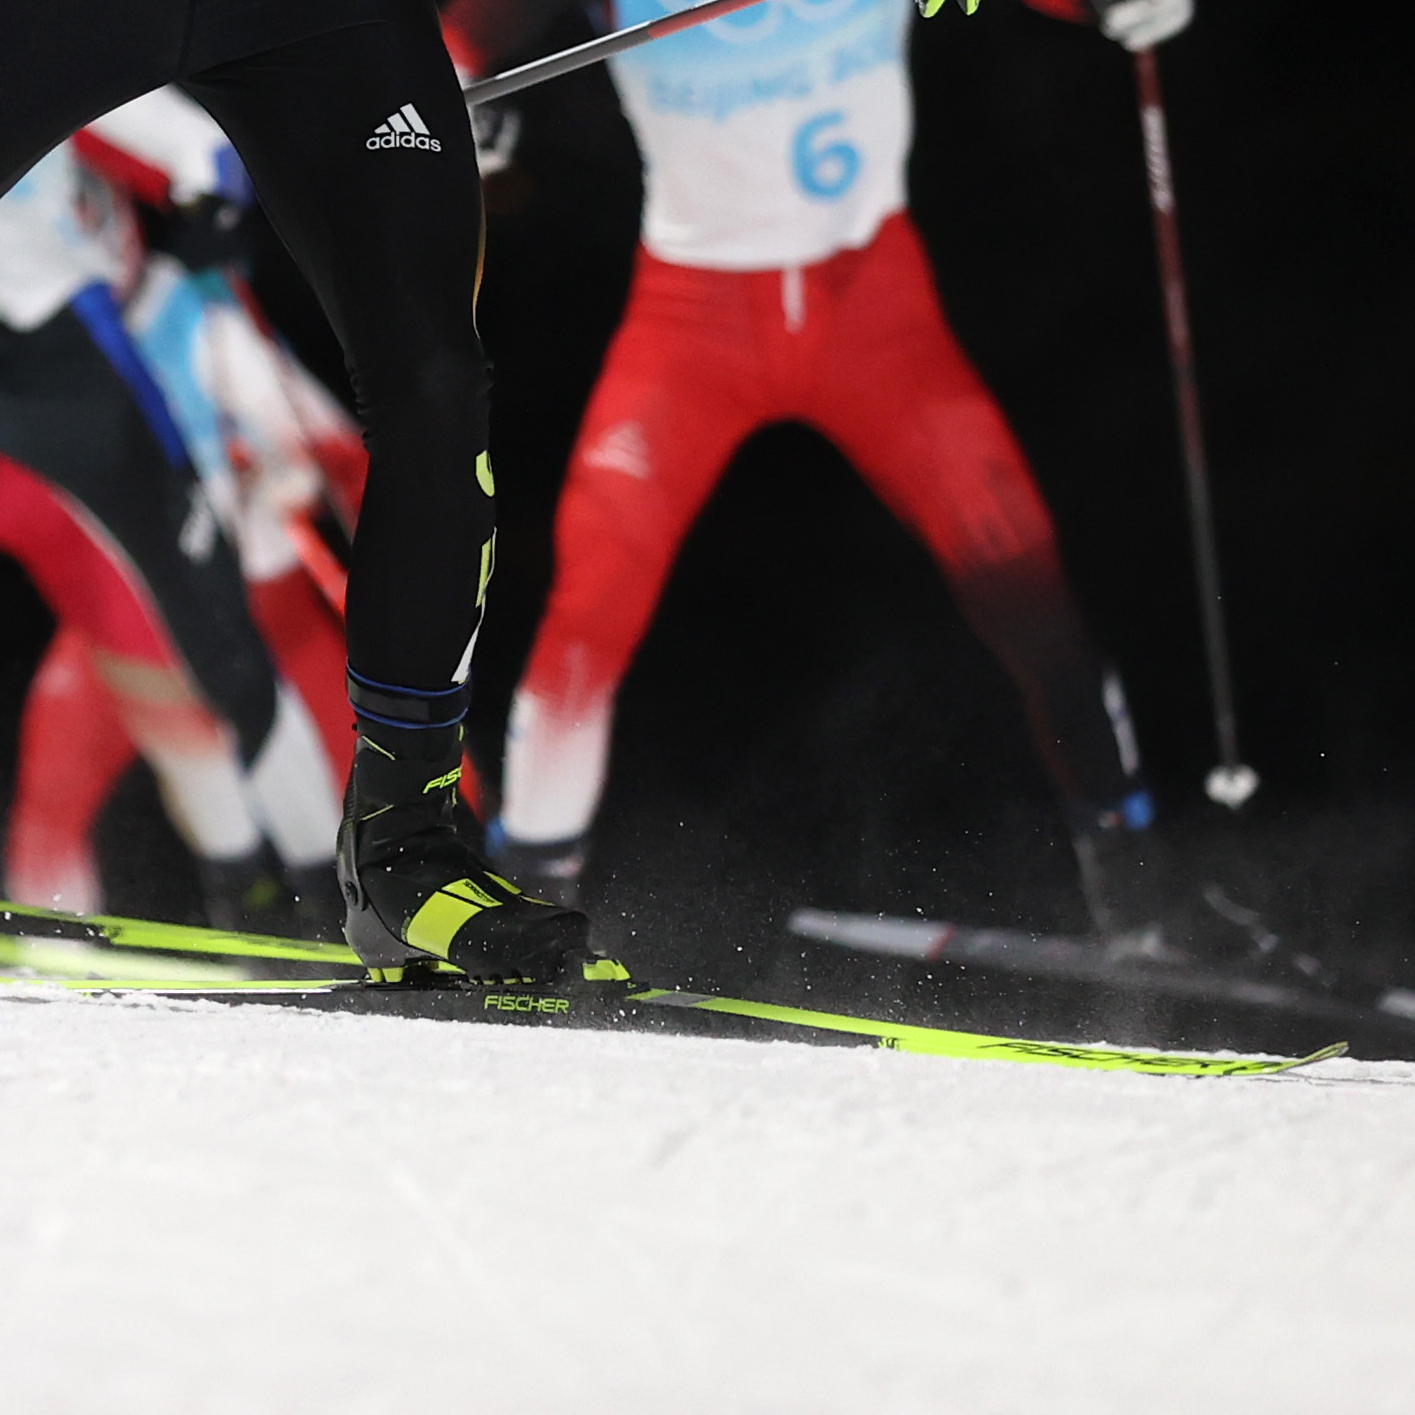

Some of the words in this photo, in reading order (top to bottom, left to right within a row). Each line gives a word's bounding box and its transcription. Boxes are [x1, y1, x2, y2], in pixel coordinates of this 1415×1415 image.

[366, 131, 442, 152] adidas
[791, 110, 861, 204] 6
[422, 764, 463, 794] FIS
[483, 993, 570, 1014] FISCHER
